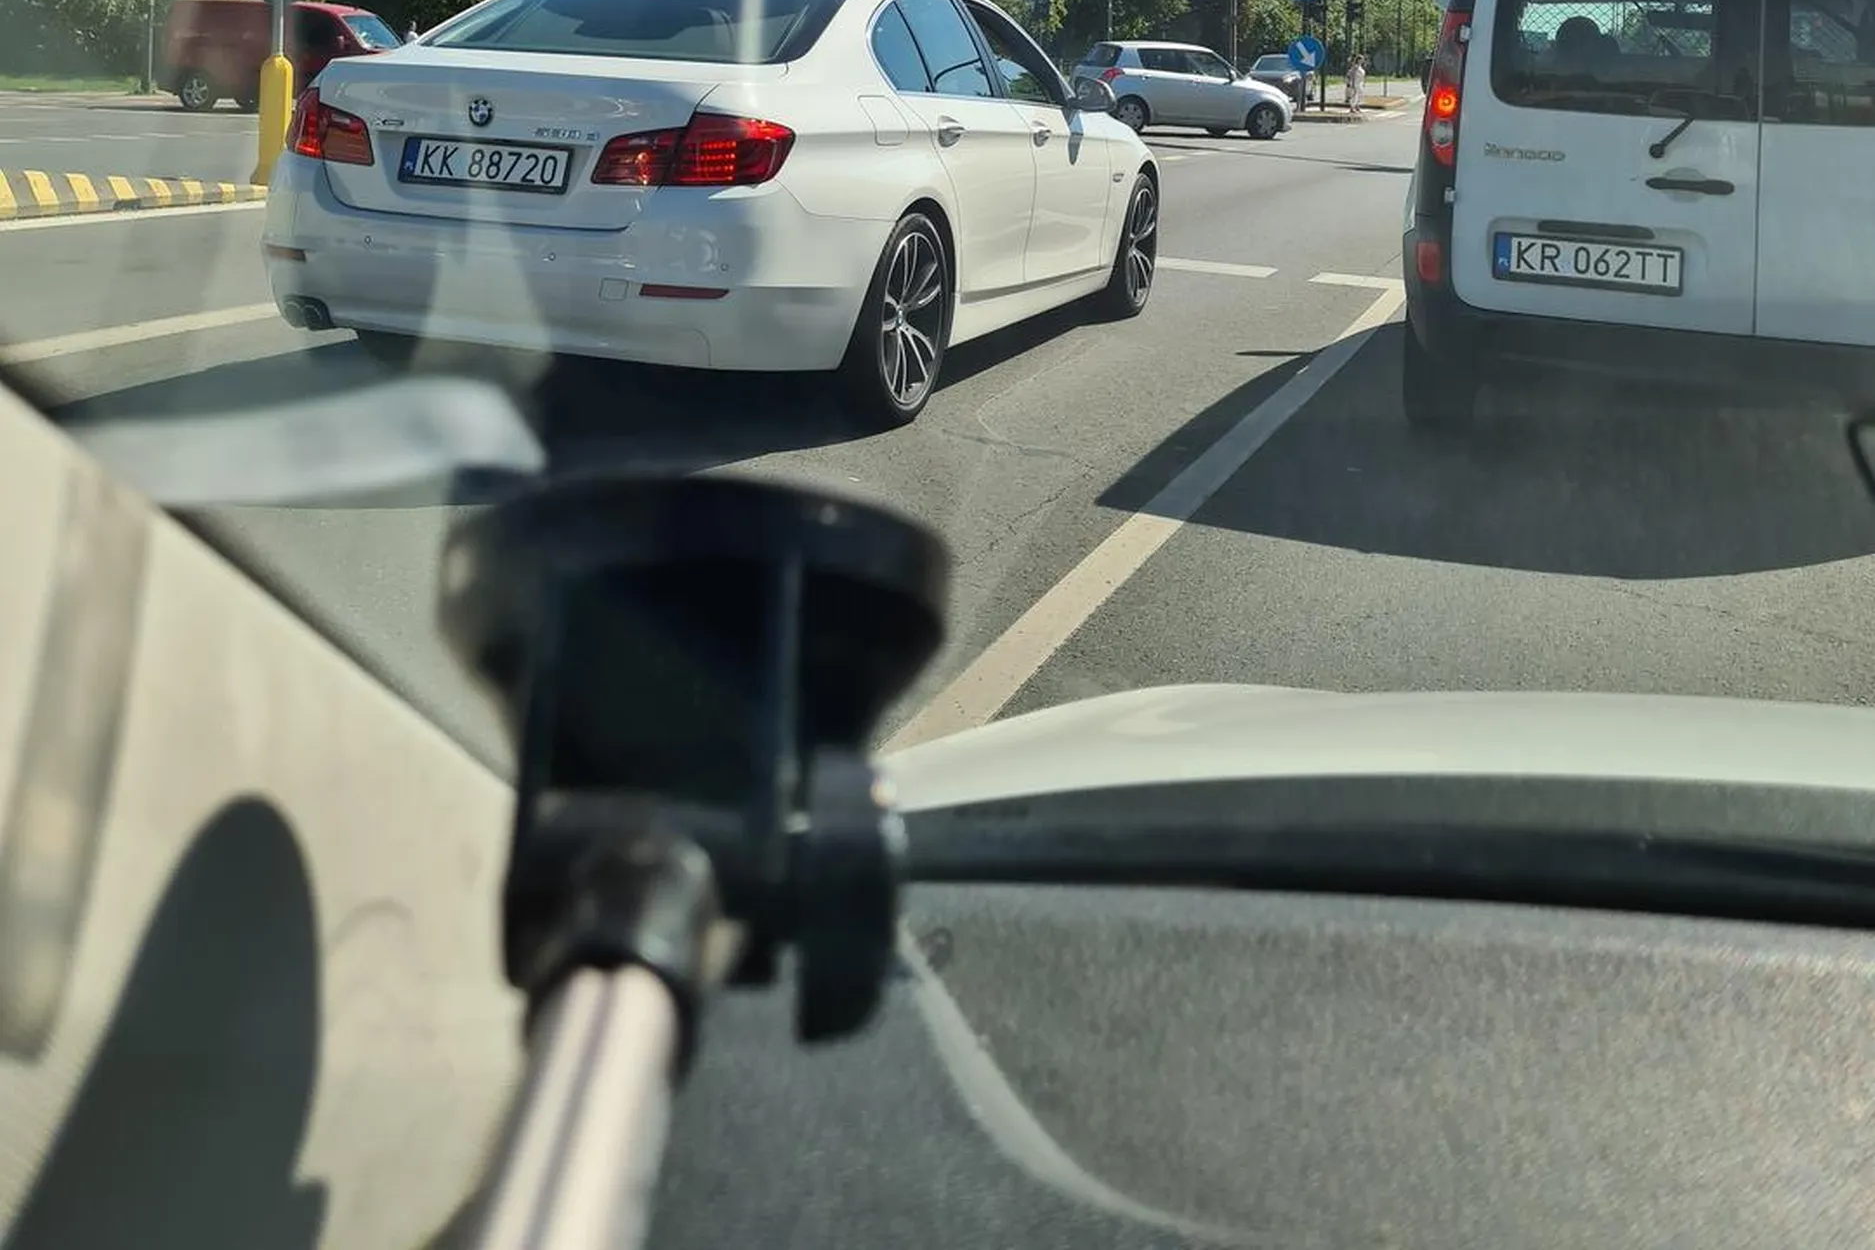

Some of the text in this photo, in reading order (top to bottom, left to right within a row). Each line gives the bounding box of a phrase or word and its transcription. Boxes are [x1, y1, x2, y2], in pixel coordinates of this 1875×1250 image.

[420, 143, 558, 185] KK 88720
[1516, 240, 1561, 273] KR
[1573, 246, 1676, 283] 062TT
